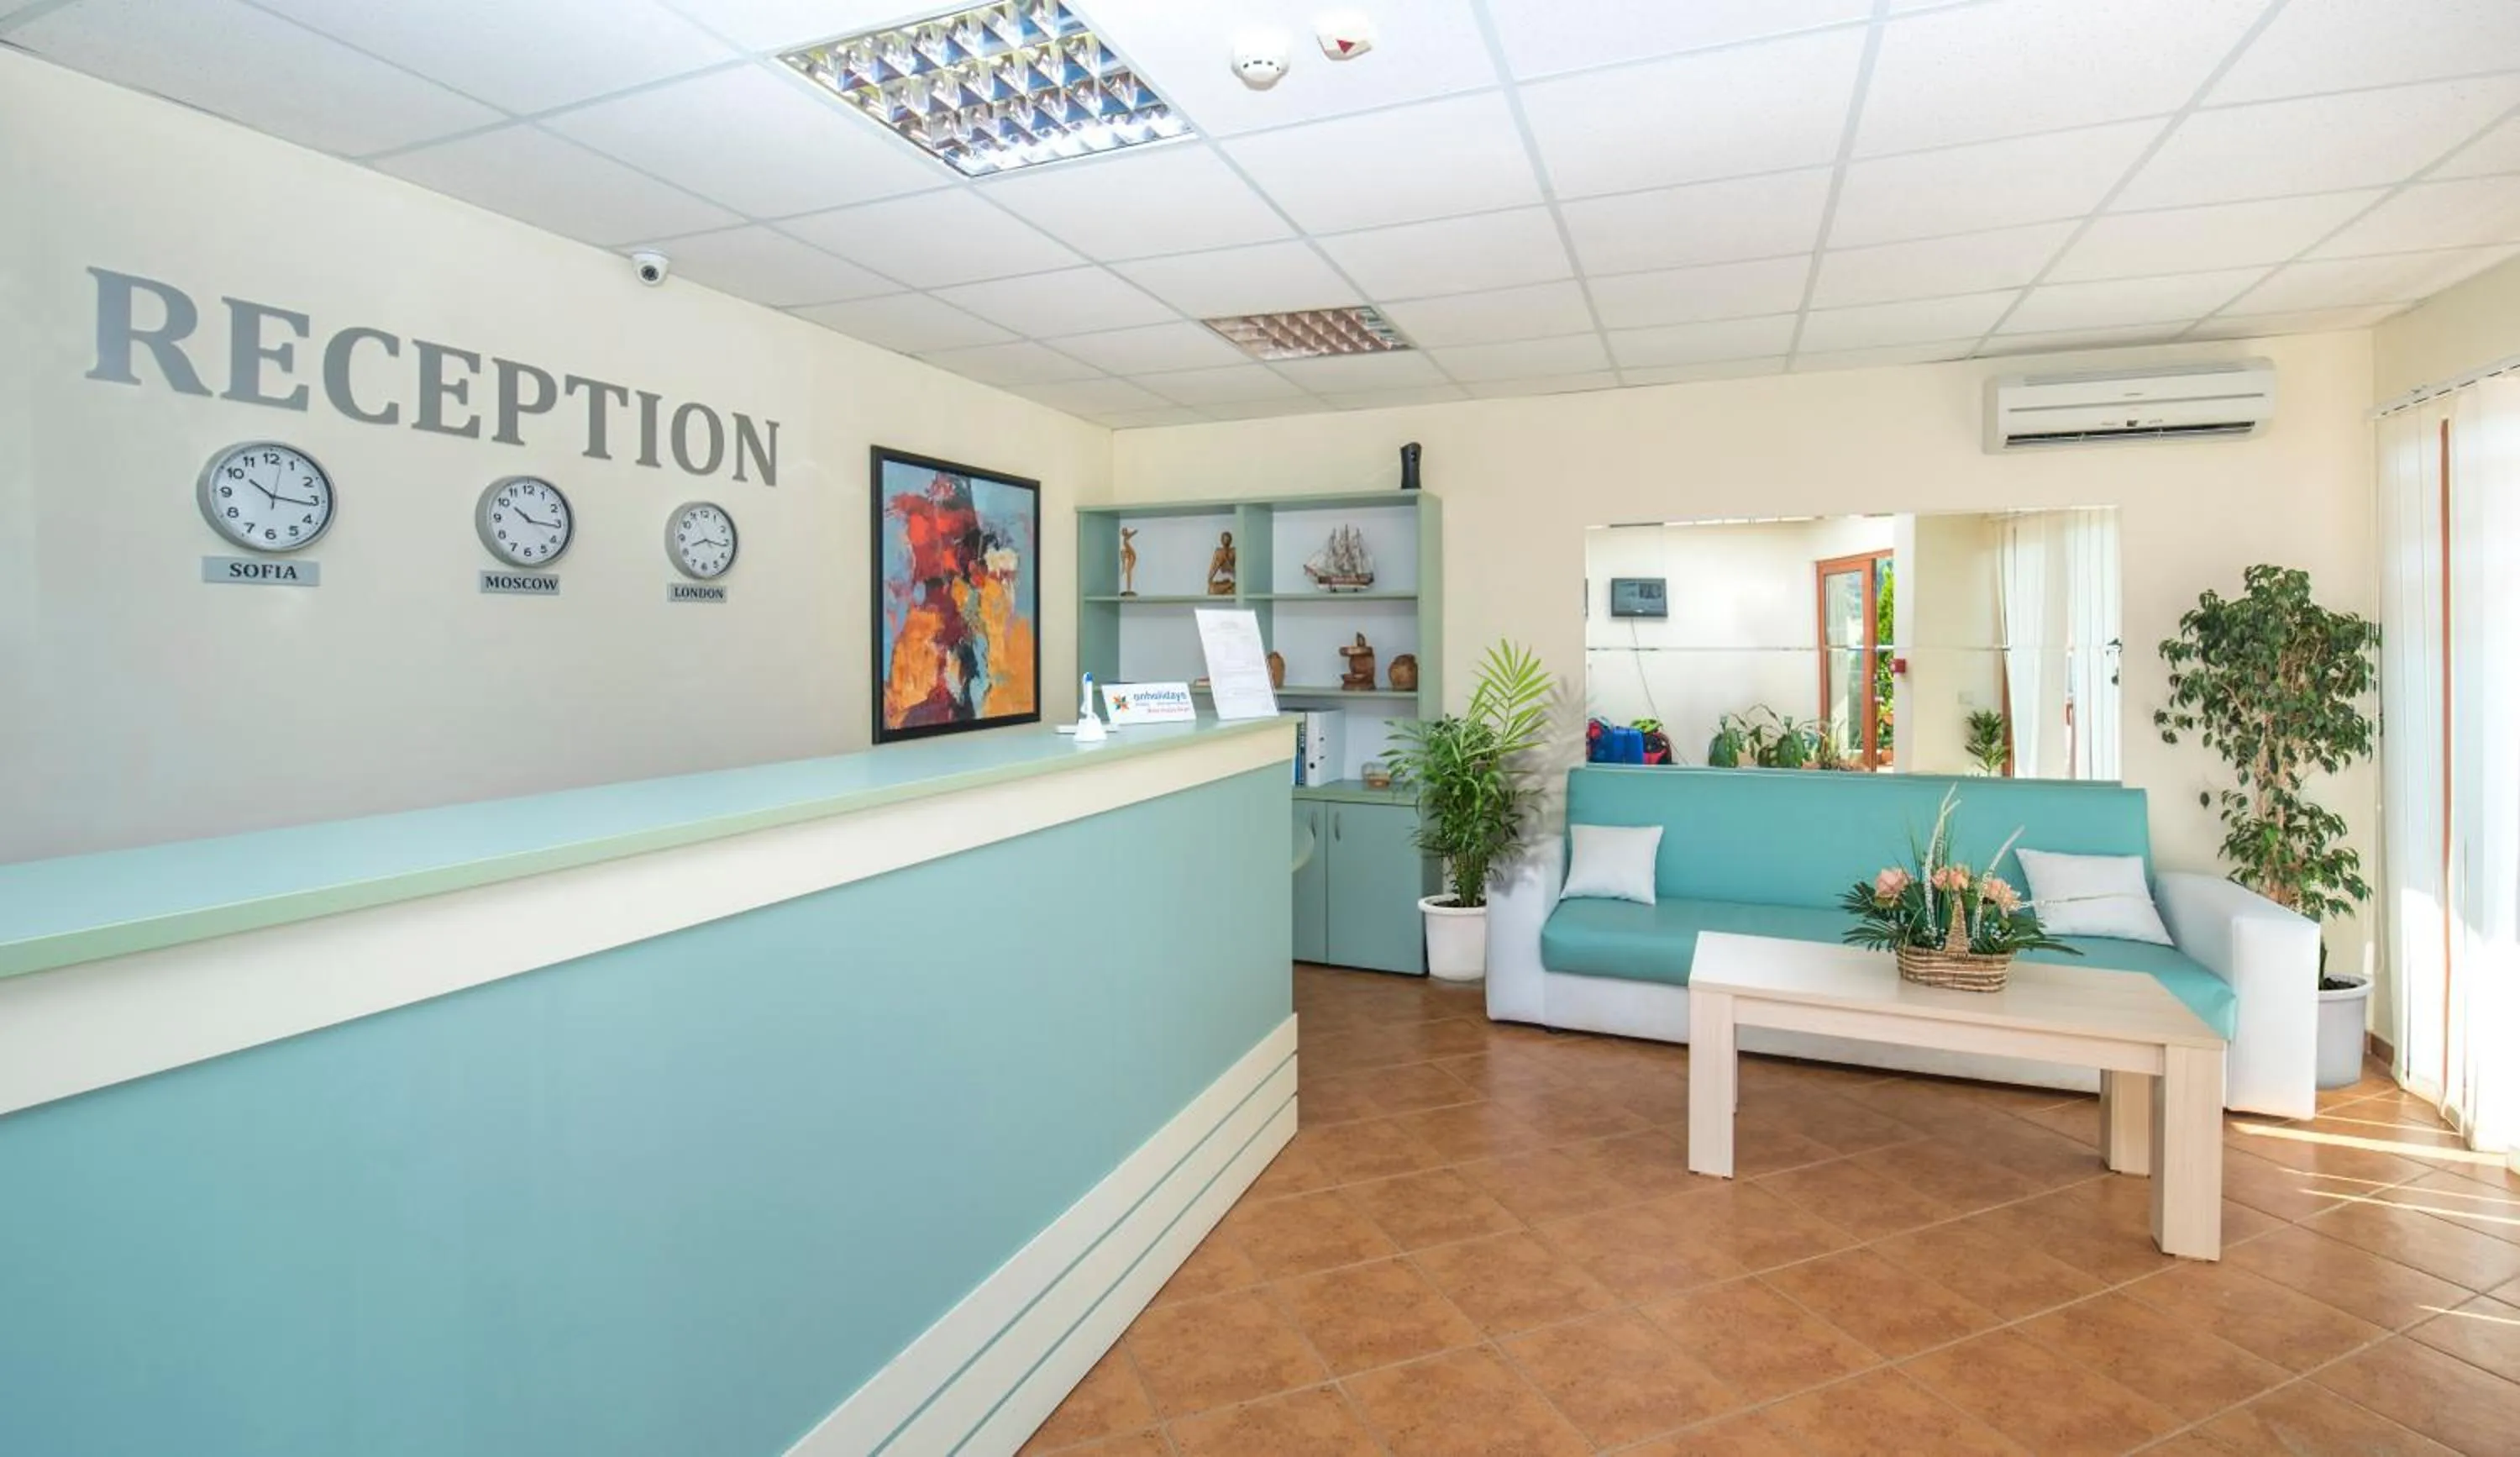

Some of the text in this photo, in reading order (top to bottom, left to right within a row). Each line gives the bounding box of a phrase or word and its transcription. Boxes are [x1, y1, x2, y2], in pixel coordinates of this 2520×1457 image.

[85, 266, 780, 486] RECEPTION
[243, 455, 255, 467] 11
[263, 452, 281, 465] 12
[289, 460, 295, 471] 1
[227, 467, 244, 479] 10
[302, 476, 314, 487] 2
[220, 487, 233, 497] 9
[509, 487, 518, 497] 11
[522, 485, 535, 496] 12
[540, 490, 545, 501] 1
[310, 495, 319, 506] 3
[498, 497, 510, 508] 10
[227, 507, 239, 518] 8
[550, 504, 558, 513] 2
[302, 513, 312, 524] 4
[493, 513, 501, 523] 9
[244, 522, 255, 534] 7
[288, 525, 299, 536] 5
[265, 529, 276, 539] 6
[510, 542, 518, 551] 7
[523, 547, 532, 556] 6
[540, 544, 548, 554] 5
[229, 562, 297, 580] SOFIA
[485, 576, 559, 590] MOSCOW
[675, 586, 724, 598] LONDON
